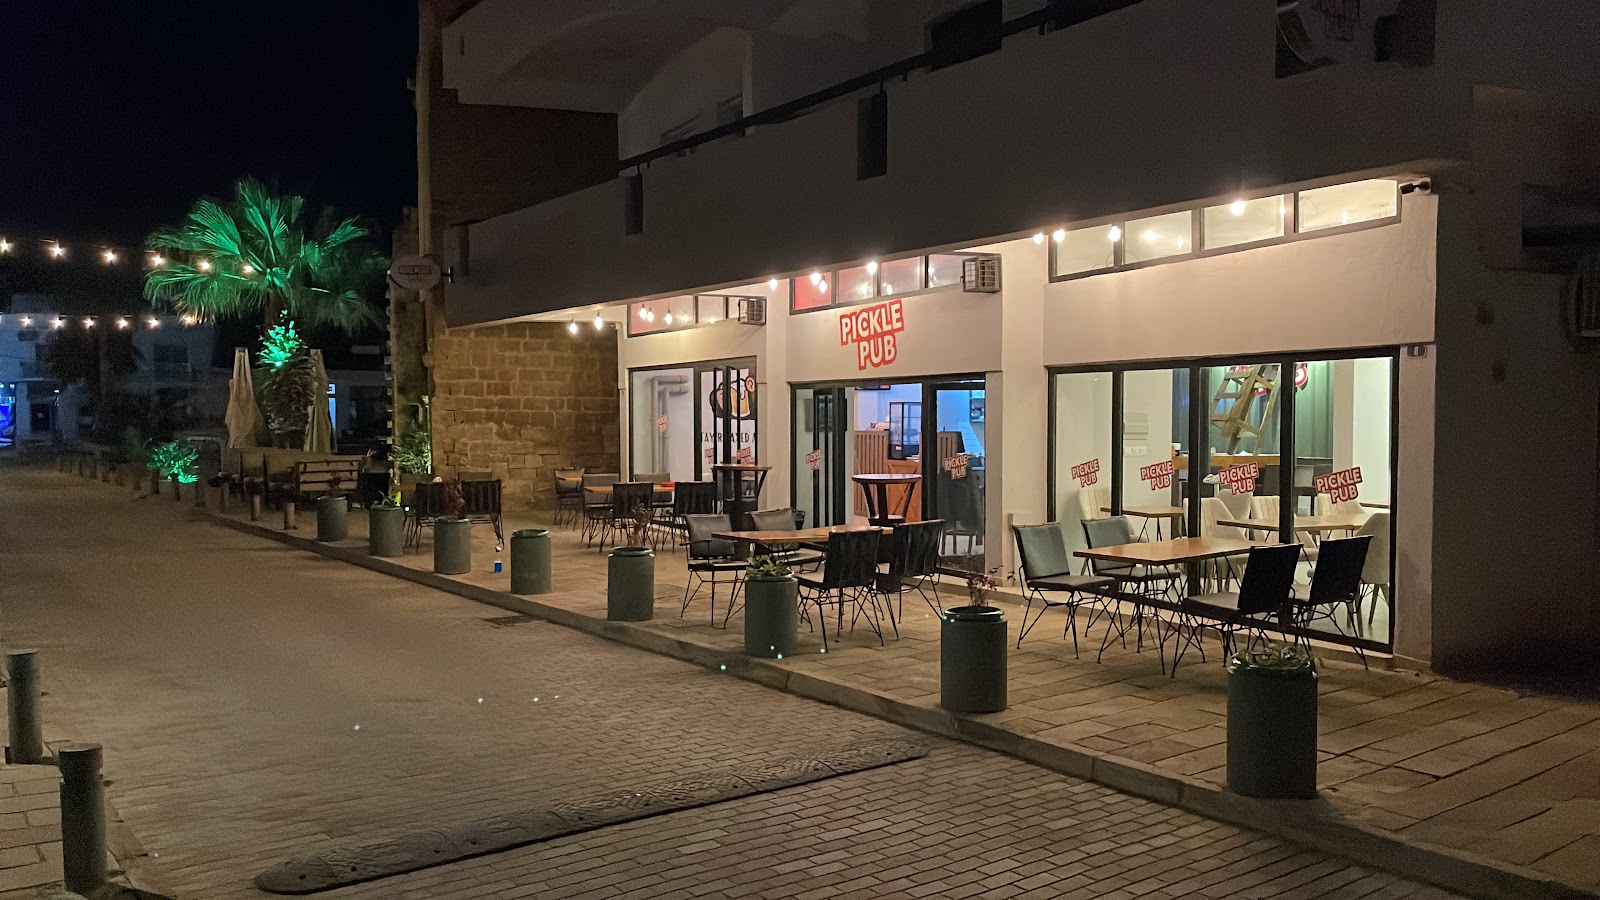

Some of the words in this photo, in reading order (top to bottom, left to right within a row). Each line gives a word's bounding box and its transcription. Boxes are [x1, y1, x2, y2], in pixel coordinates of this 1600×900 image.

[841, 302, 903, 344] PICKLE
[859, 333, 896, 369] PUB
[944, 455, 968, 471] PICKLE
[951, 466, 967, 479] PUB
[1072, 459, 1099, 478] PICKLE
[1141, 461, 1173, 480] PICKLE
[1080, 472, 1097, 487] PUB
[1151, 474, 1171, 490] PUB
[1219, 463, 1259, 484] PICKLE
[1316, 467, 1362, 492] PICKLE
[1231, 478, 1255, 494] PUB
[1330, 484, 1358, 503] PUB
